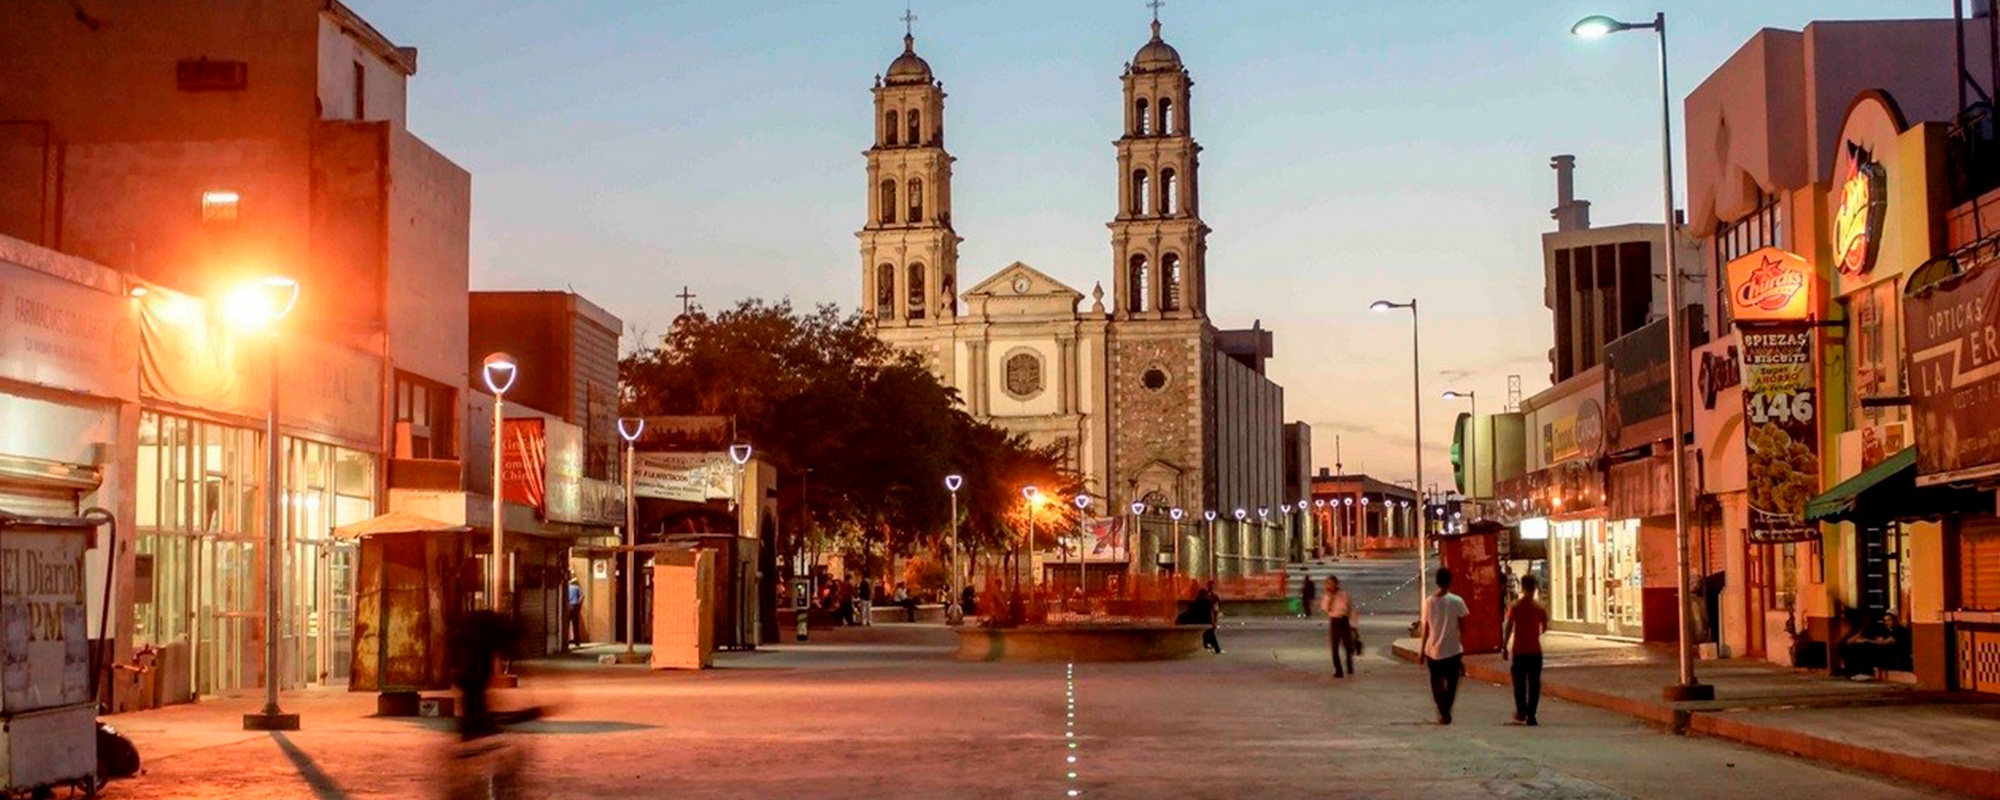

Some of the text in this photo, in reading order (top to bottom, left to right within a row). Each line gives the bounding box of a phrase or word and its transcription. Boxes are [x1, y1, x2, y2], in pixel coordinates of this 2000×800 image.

[1927, 297, 1982, 340] OPTICAS
[3, 548, 76, 597] El Diario
[27, 602, 64, 641] PM
